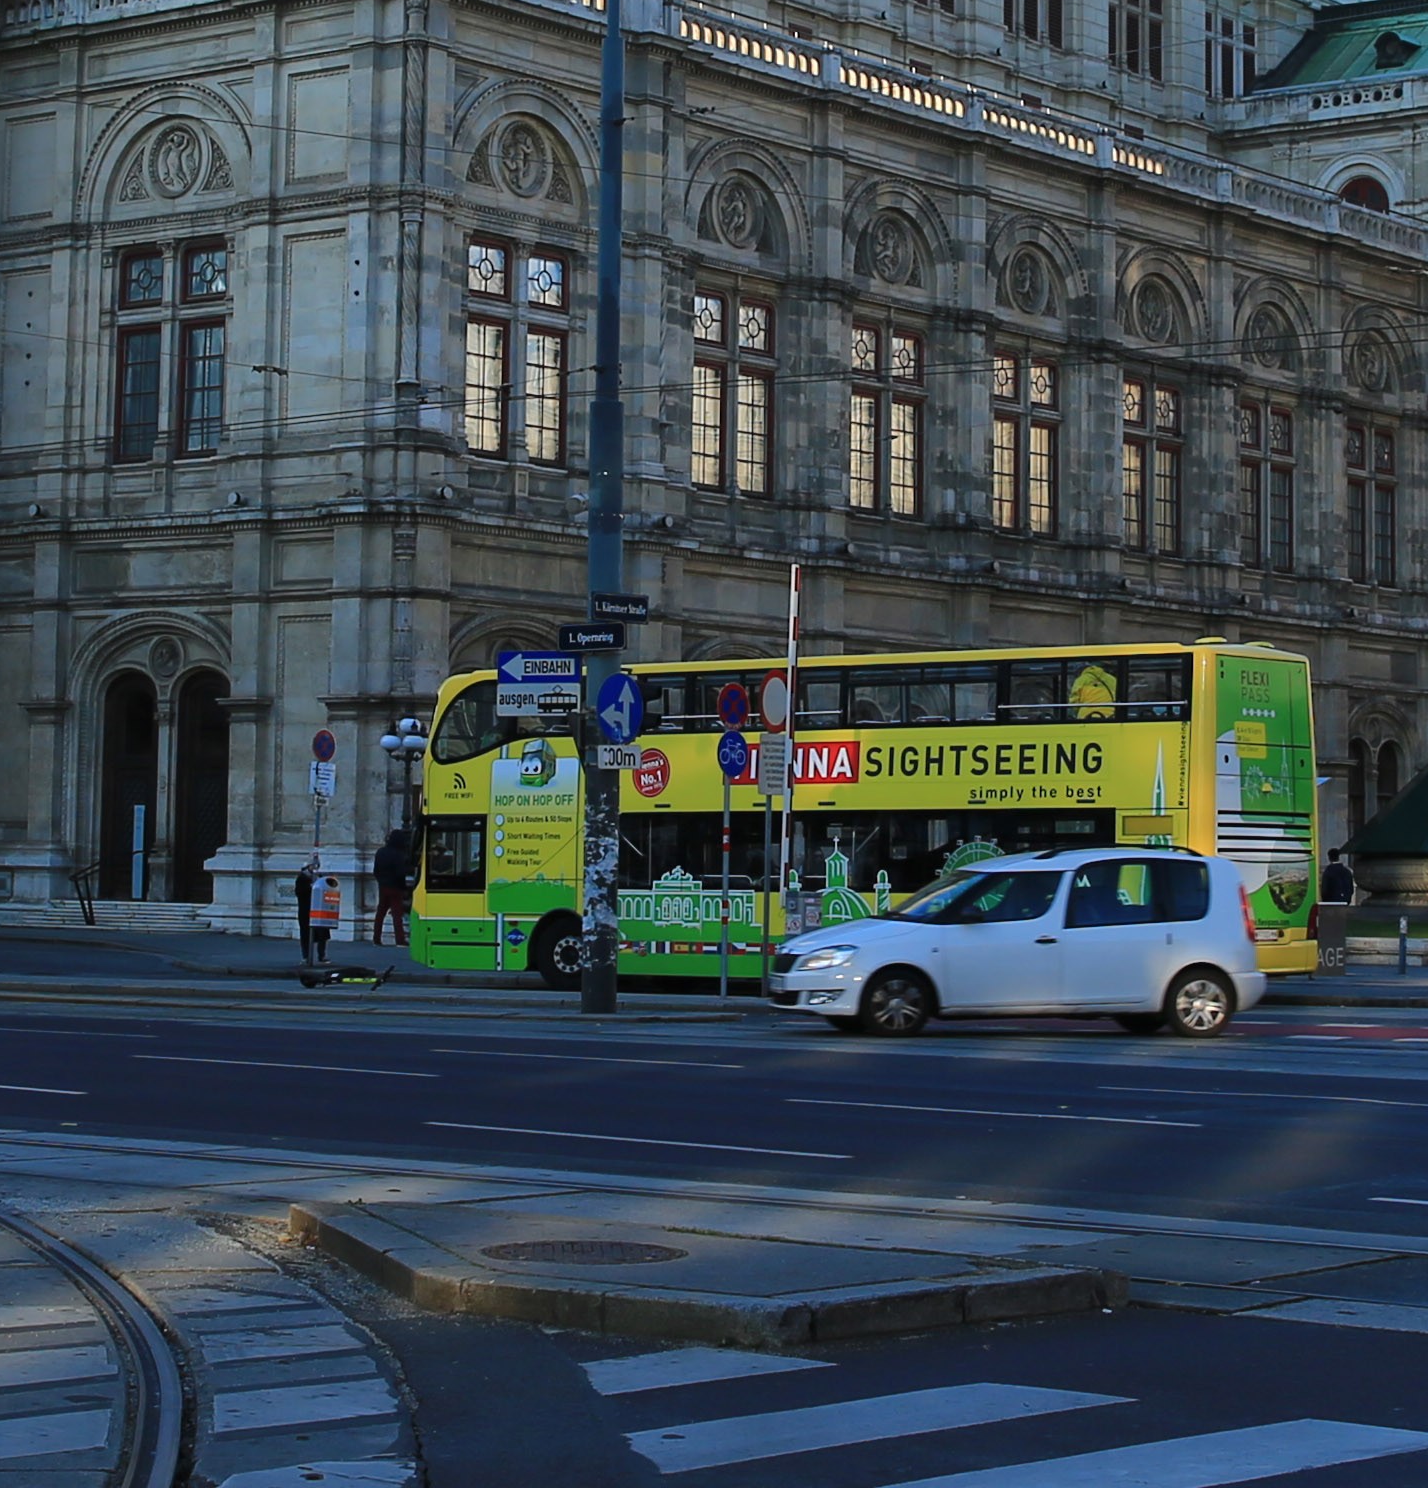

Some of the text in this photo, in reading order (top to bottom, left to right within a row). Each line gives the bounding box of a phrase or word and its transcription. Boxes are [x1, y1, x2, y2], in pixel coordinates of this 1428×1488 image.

[577, 632, 614, 645] Opernring
[524, 660, 571, 674] EINBAHN
[1241, 670, 1269, 686] FLEXI
[499, 694, 536, 709] ausgen.
[1241, 687, 1270, 703] PASS
[727, 747, 853, 780] INNA
[864, 742, 1103, 777] SIGHTSEEING
[495, 794, 574, 806] HOP ON HOP OFF
[970, 785, 1102, 802] simply the best
